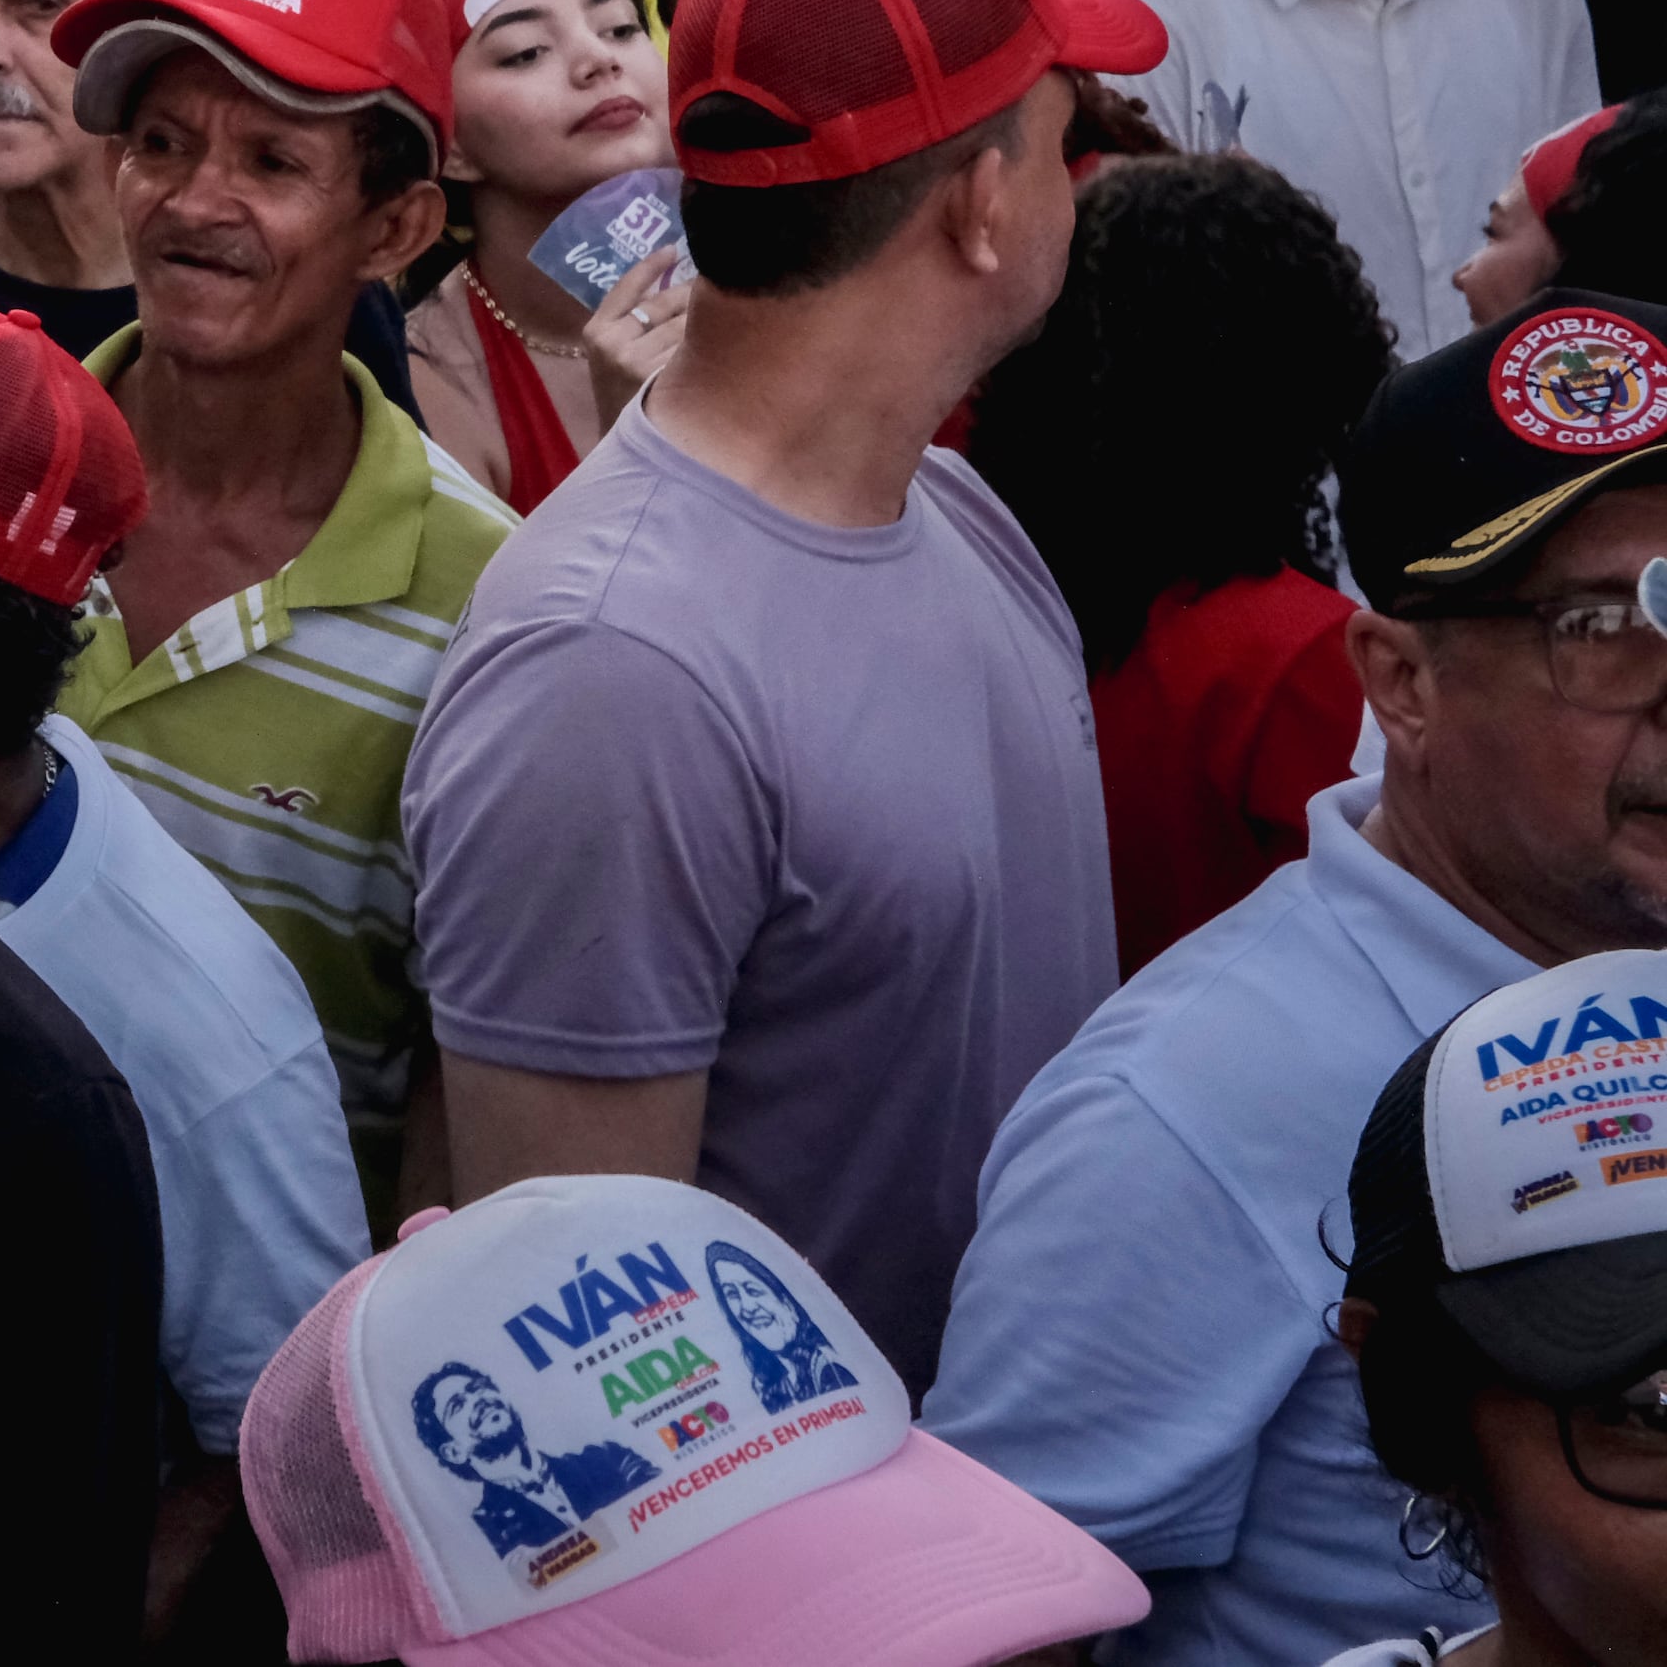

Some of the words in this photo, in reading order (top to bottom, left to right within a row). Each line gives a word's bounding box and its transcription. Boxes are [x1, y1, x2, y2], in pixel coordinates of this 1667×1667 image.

[609, 223, 650, 256] MAYO
[623, 202, 664, 240] 31
[1501, 316, 1650, 379] REPUBLICA
[1513, 408, 1548, 437] DE
[1483, 1050, 1586, 1093] CEPEDA
[1500, 1091, 1568, 1127] AIDA
[503, 1240, 693, 1373] IVÁN
[632, 1287, 700, 1325] CEPEDA
[573, 1310, 685, 1374] PRESIDENTE
[599, 1335, 716, 1420] AIDA
[631, 1378, 720, 1429] VICEPRESIDENTA
[627, 1435, 775, 1535] ¡VENCEREMOS
[771, 1422, 801, 1448] EN
[797, 1396, 868, 1436] PRIMERA!
